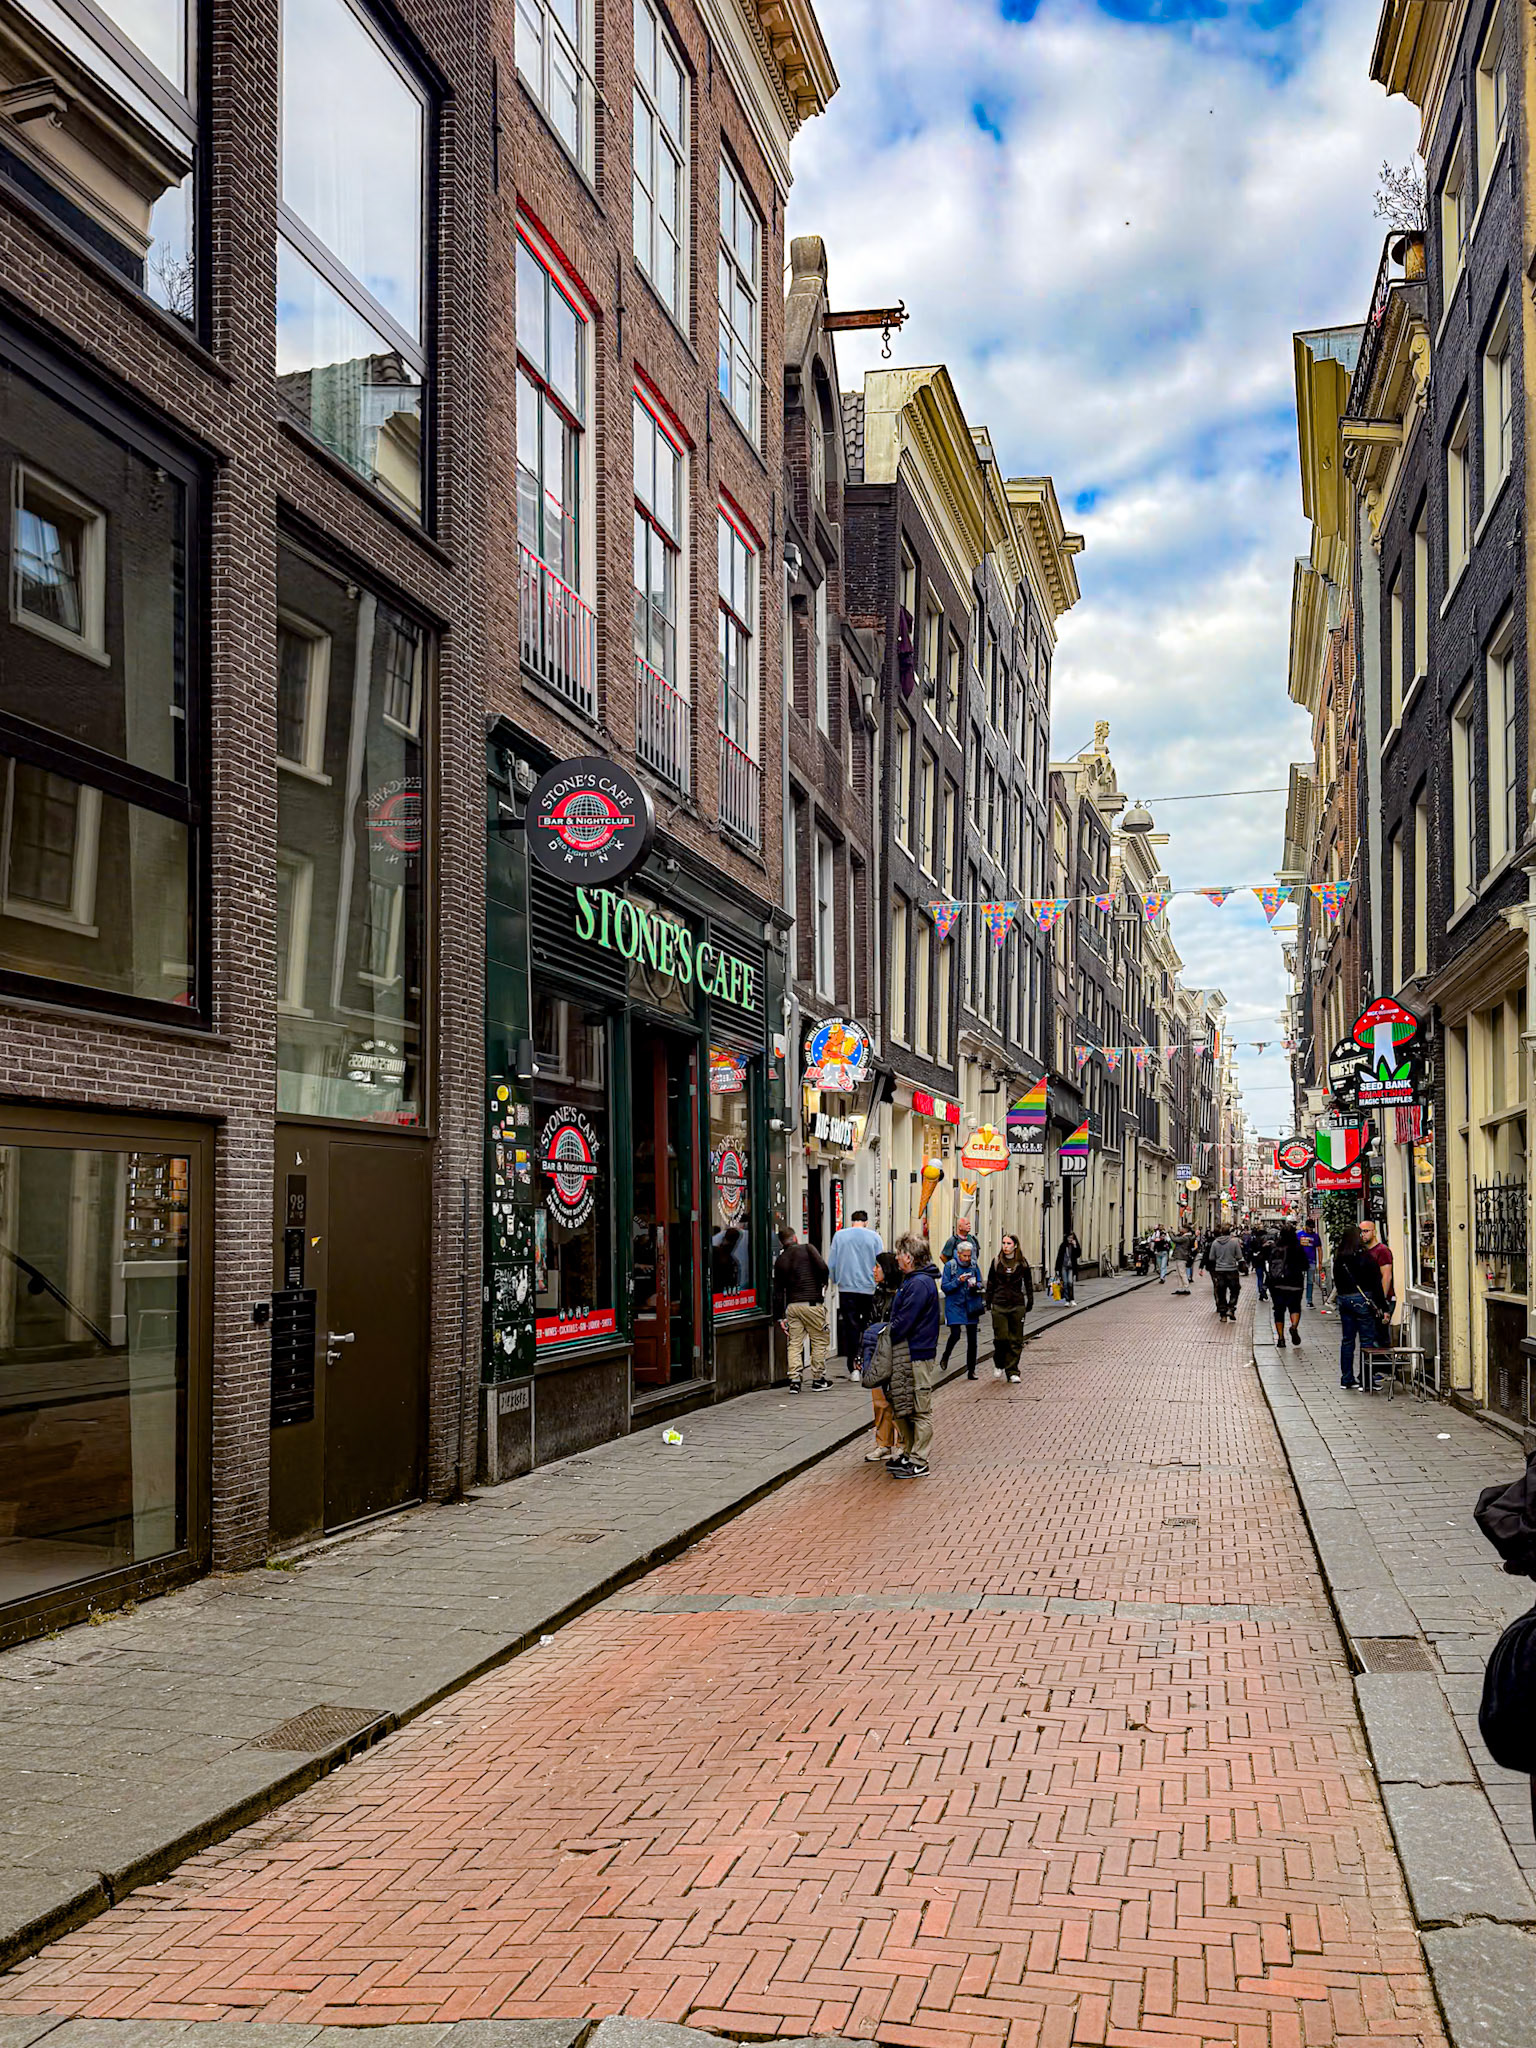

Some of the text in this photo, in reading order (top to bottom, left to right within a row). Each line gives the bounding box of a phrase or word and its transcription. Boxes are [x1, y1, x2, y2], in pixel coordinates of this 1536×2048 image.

[541, 774, 634, 810] STONE'S CAFÉ
[543, 816, 630, 826] BAR & NIGHTCLUB
[567, 847, 588, 858] LIGHT
[576, 886, 755, 1011] STONE'S CAFE
[807, 1027, 820, 1041] WILL
[824, 1017, 844, 1026] NEVER
[1360, 1080, 1411, 1091] SEED BANK
[1358, 1088, 1413, 1099] SMARTSHOP
[1358, 1096, 1413, 1106] MAGIC TRUFFLES
[541, 1105, 577, 1149] STONE'S
[815, 1113, 853, 1146] BIG SHOTS
[541, 1160, 598, 1175] BAR & NIGHTCLUB
[1061, 1156, 1087, 1171] DD
[290, 1194, 304, 1210] 98
[546, 1194, 567, 1228] DRINK
[574, 1196, 595, 1228] DANCE
